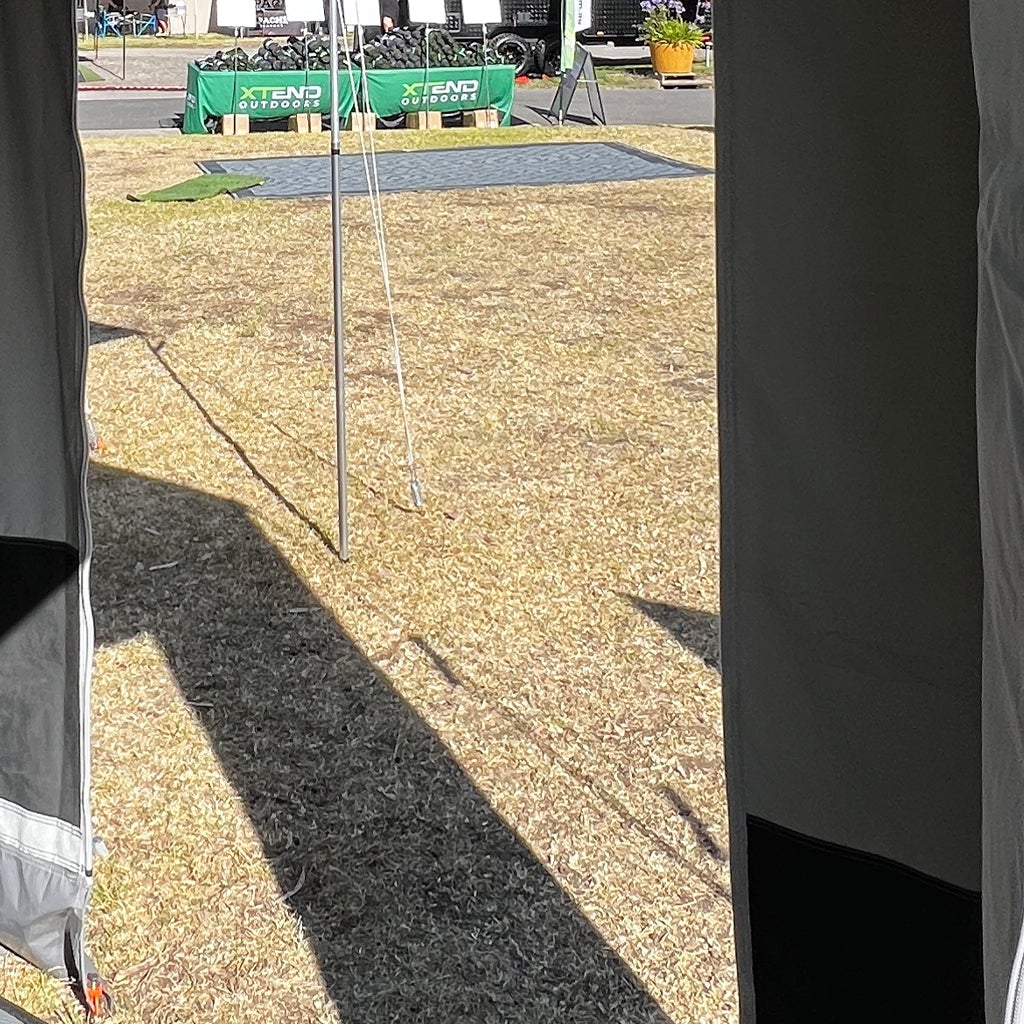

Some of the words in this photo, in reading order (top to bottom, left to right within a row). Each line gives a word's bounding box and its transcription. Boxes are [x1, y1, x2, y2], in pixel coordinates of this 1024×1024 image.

[239, 86, 322, 100] XTEND
[402, 80, 479, 96] XTEND
[238, 99, 321, 109] OUTDOORS
[401, 93, 477, 105] OUTDOORS
